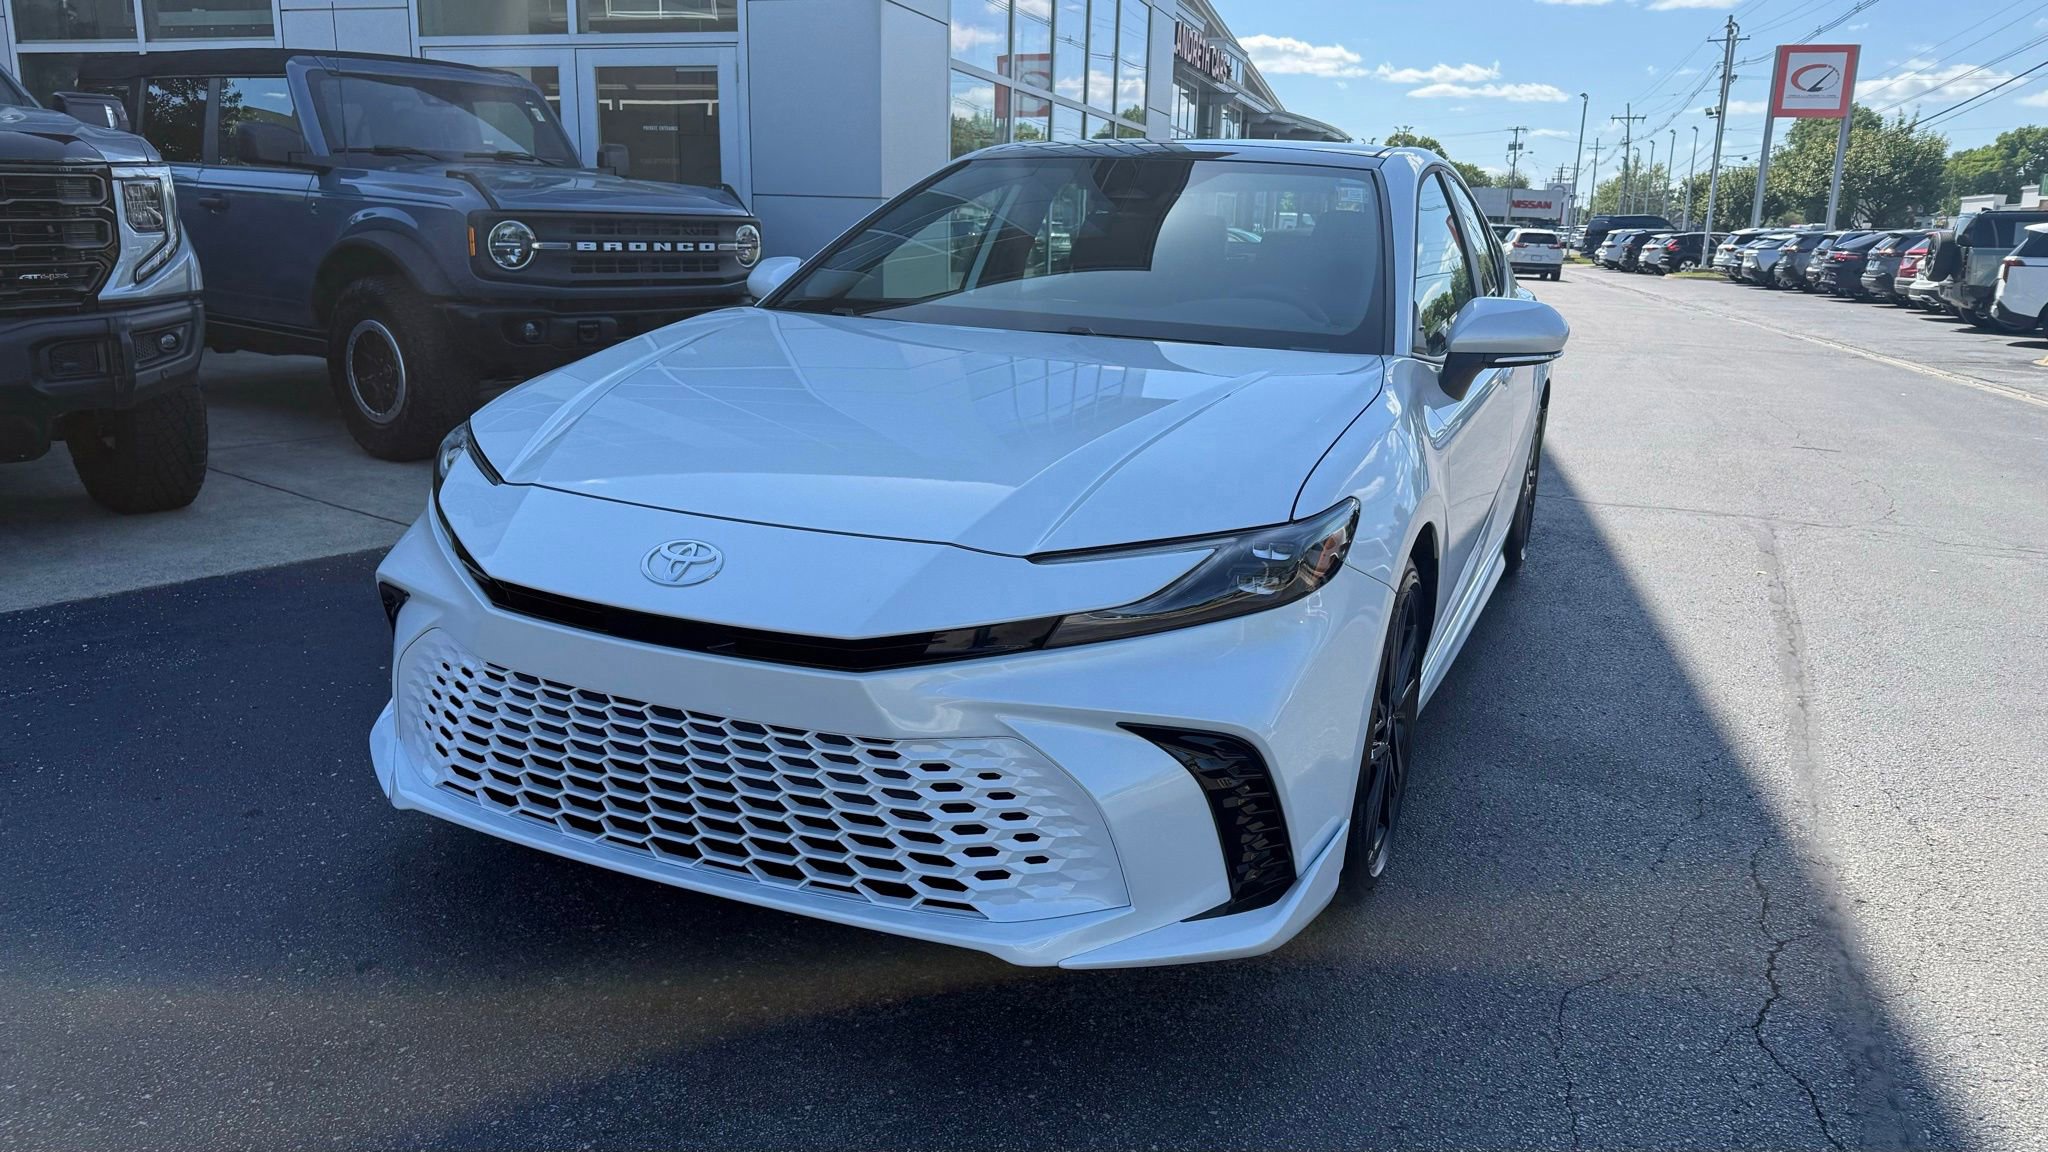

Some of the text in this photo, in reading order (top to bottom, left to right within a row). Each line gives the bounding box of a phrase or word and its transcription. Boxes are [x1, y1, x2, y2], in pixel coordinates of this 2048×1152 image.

[1175, 21, 1210, 74] ANDRETH
[1511, 200, 1552, 209] NISSAN
[576, 241, 716, 252] BRONCO
